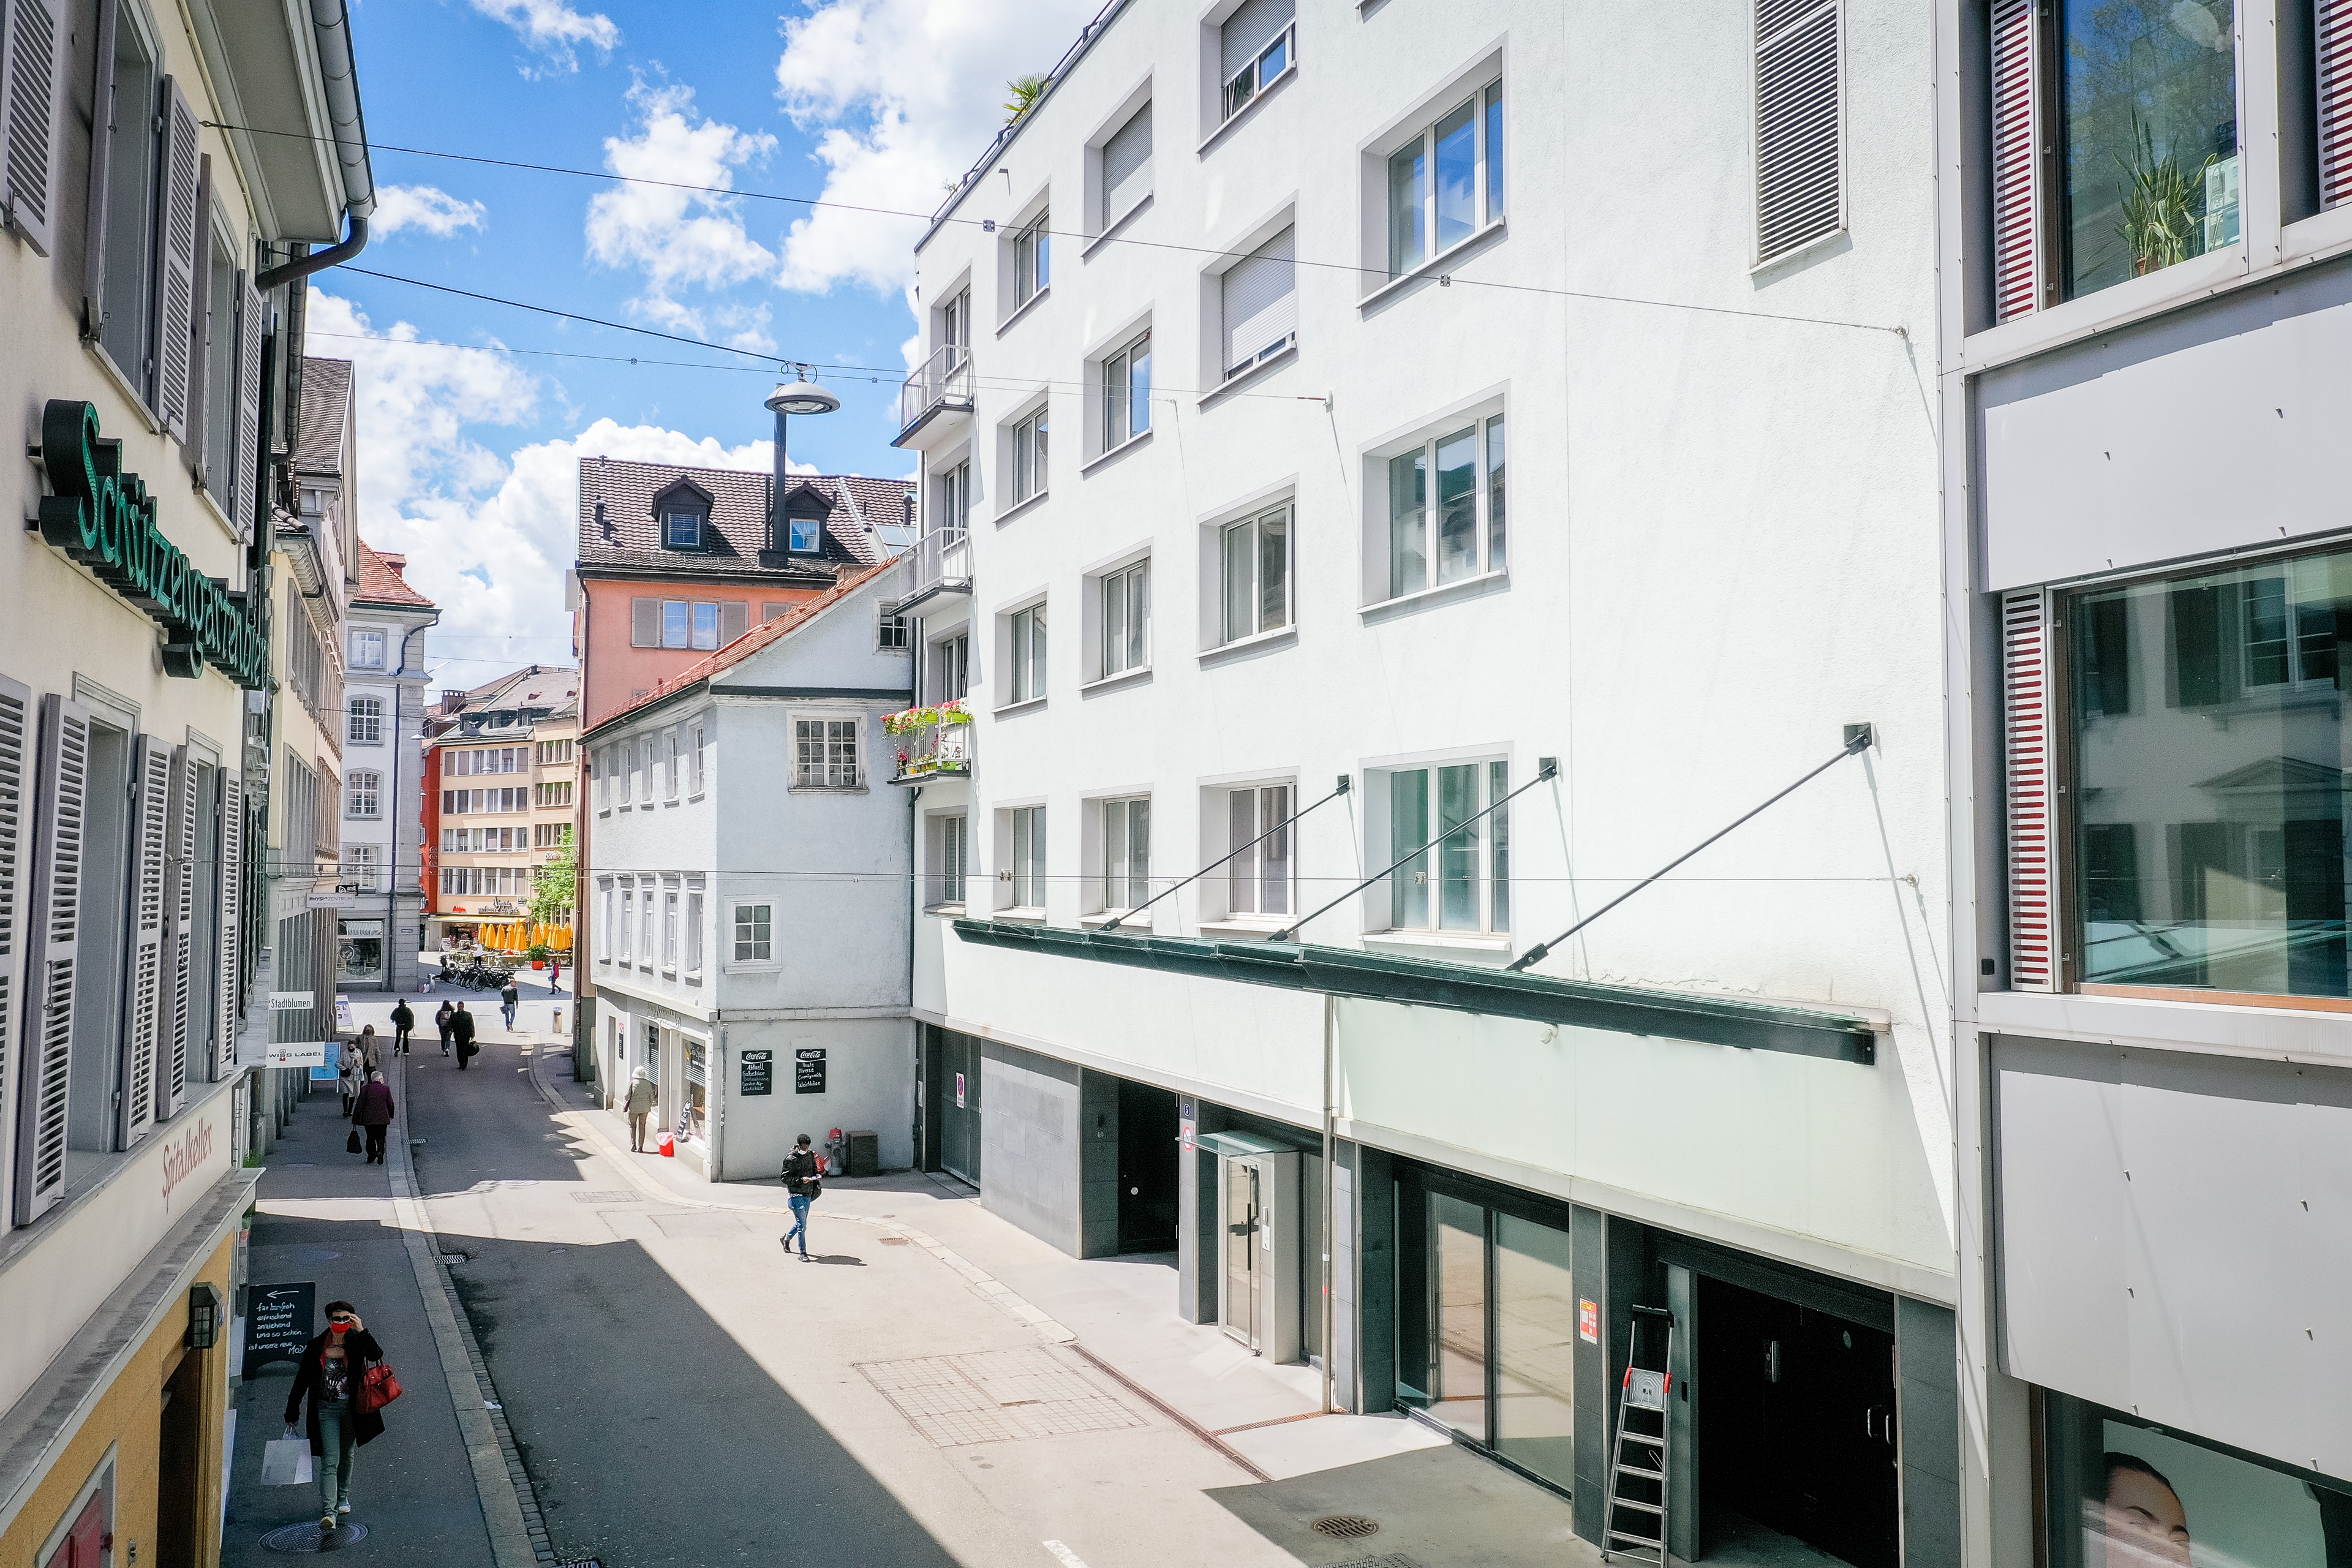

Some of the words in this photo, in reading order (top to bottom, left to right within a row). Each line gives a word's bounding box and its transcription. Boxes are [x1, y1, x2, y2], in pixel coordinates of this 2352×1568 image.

[271, 998, 310, 1008] Stadtblumen
[162, 1117, 212, 1215] Spitalkeller
[288, 1344, 307, 1354] MOD
